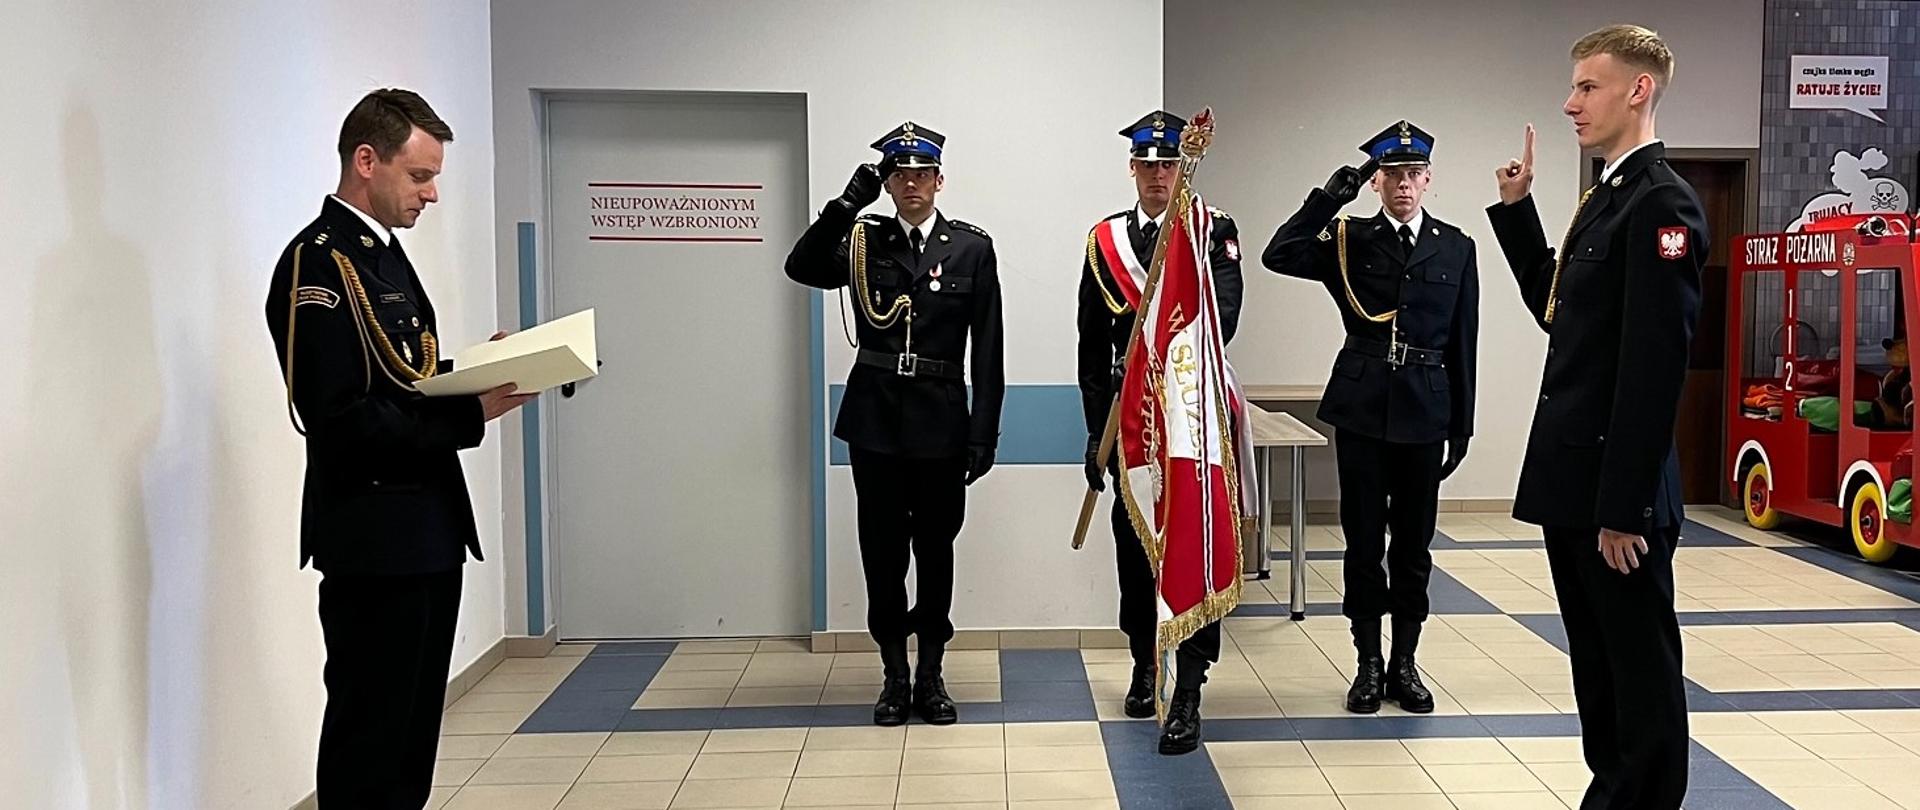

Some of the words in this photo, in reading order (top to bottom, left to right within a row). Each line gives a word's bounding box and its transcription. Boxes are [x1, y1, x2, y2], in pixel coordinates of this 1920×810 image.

[1796, 84, 1840, 95] RATUJE
[1843, 81, 1882, 96] ŻYCIE!
[591, 194, 755, 211] NIEUPOWAŻNIONYM
[591, 215, 646, 230] WSTĘP
[650, 216, 760, 229] WZBRONIONY
